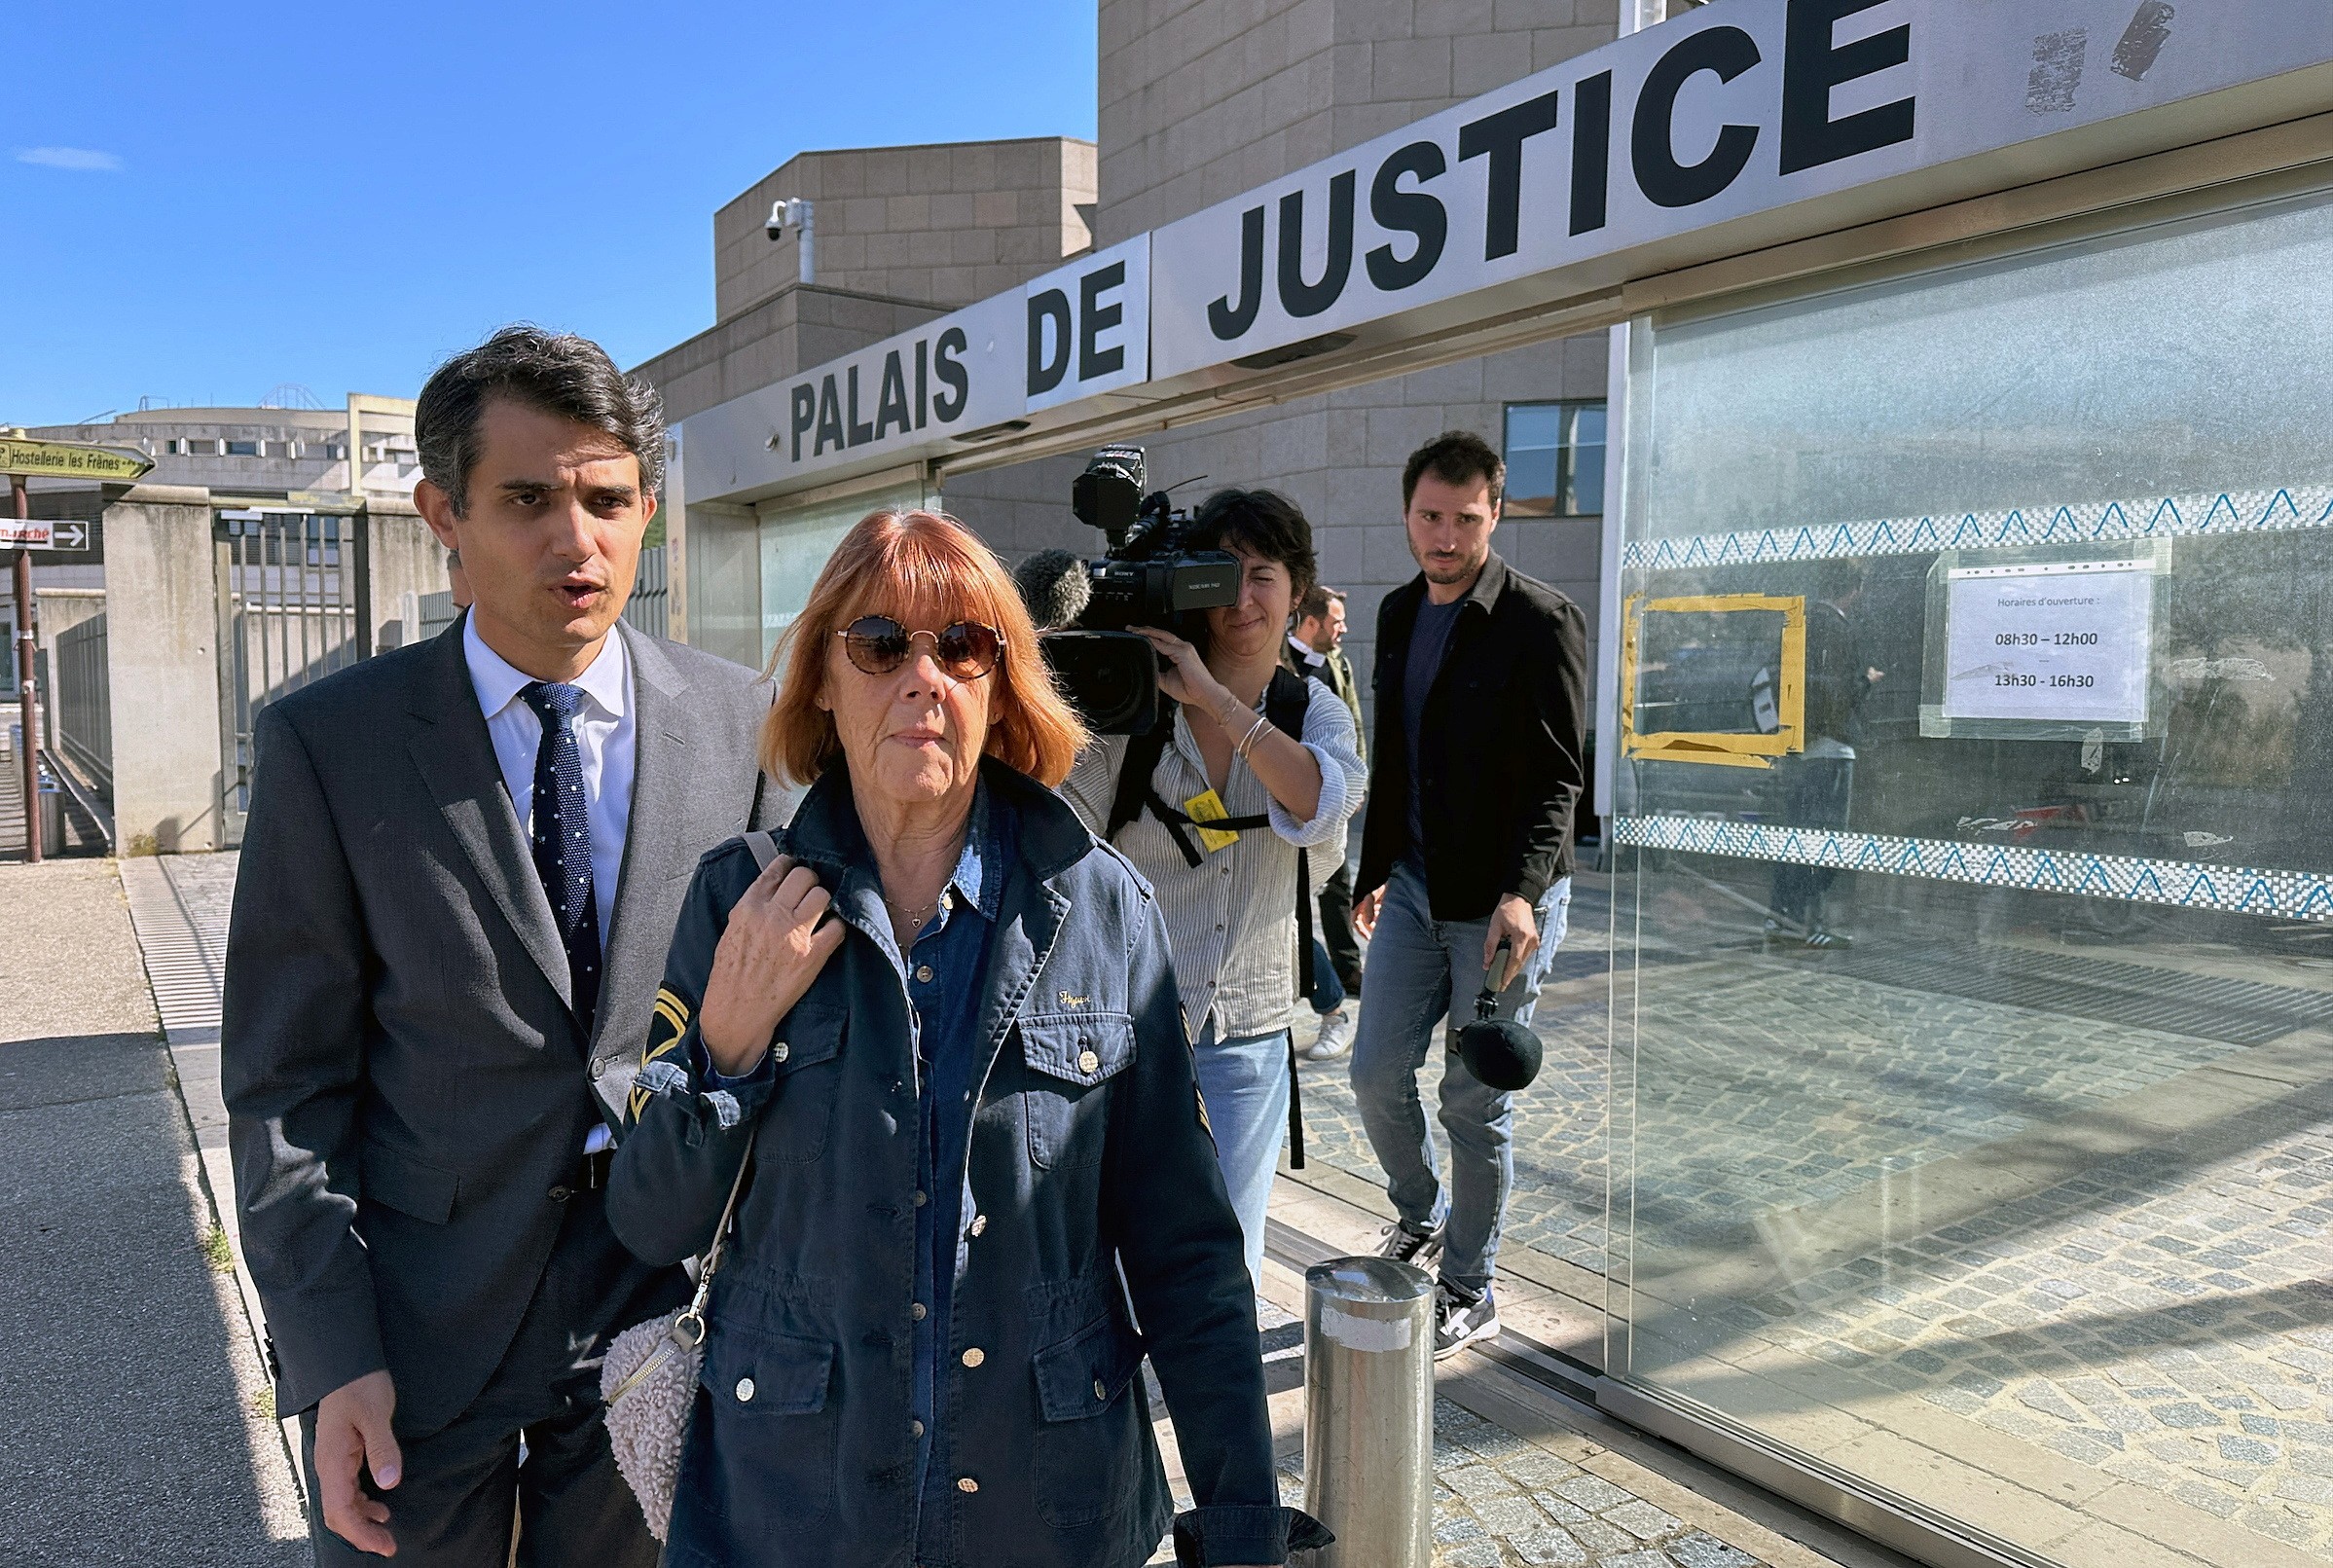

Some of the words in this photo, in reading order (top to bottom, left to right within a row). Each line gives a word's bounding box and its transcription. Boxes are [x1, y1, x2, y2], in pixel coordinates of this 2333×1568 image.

[791, 327, 968, 462] PALAIS
[1027, 260, 1125, 398] DE
[1207, 0, 1916, 341] JUSTICE
[12, 449, 64, 466] Hostellerie
[68, 453, 83, 468] les
[1997, 598, 2036, 607] Horaires
[1995, 634, 2037, 646] 08h30
[2054, 633, 2097, 645] 12h00
[1994, 675, 2036, 687] 13h30
[2049, 675, 2095, 687] 16h30
